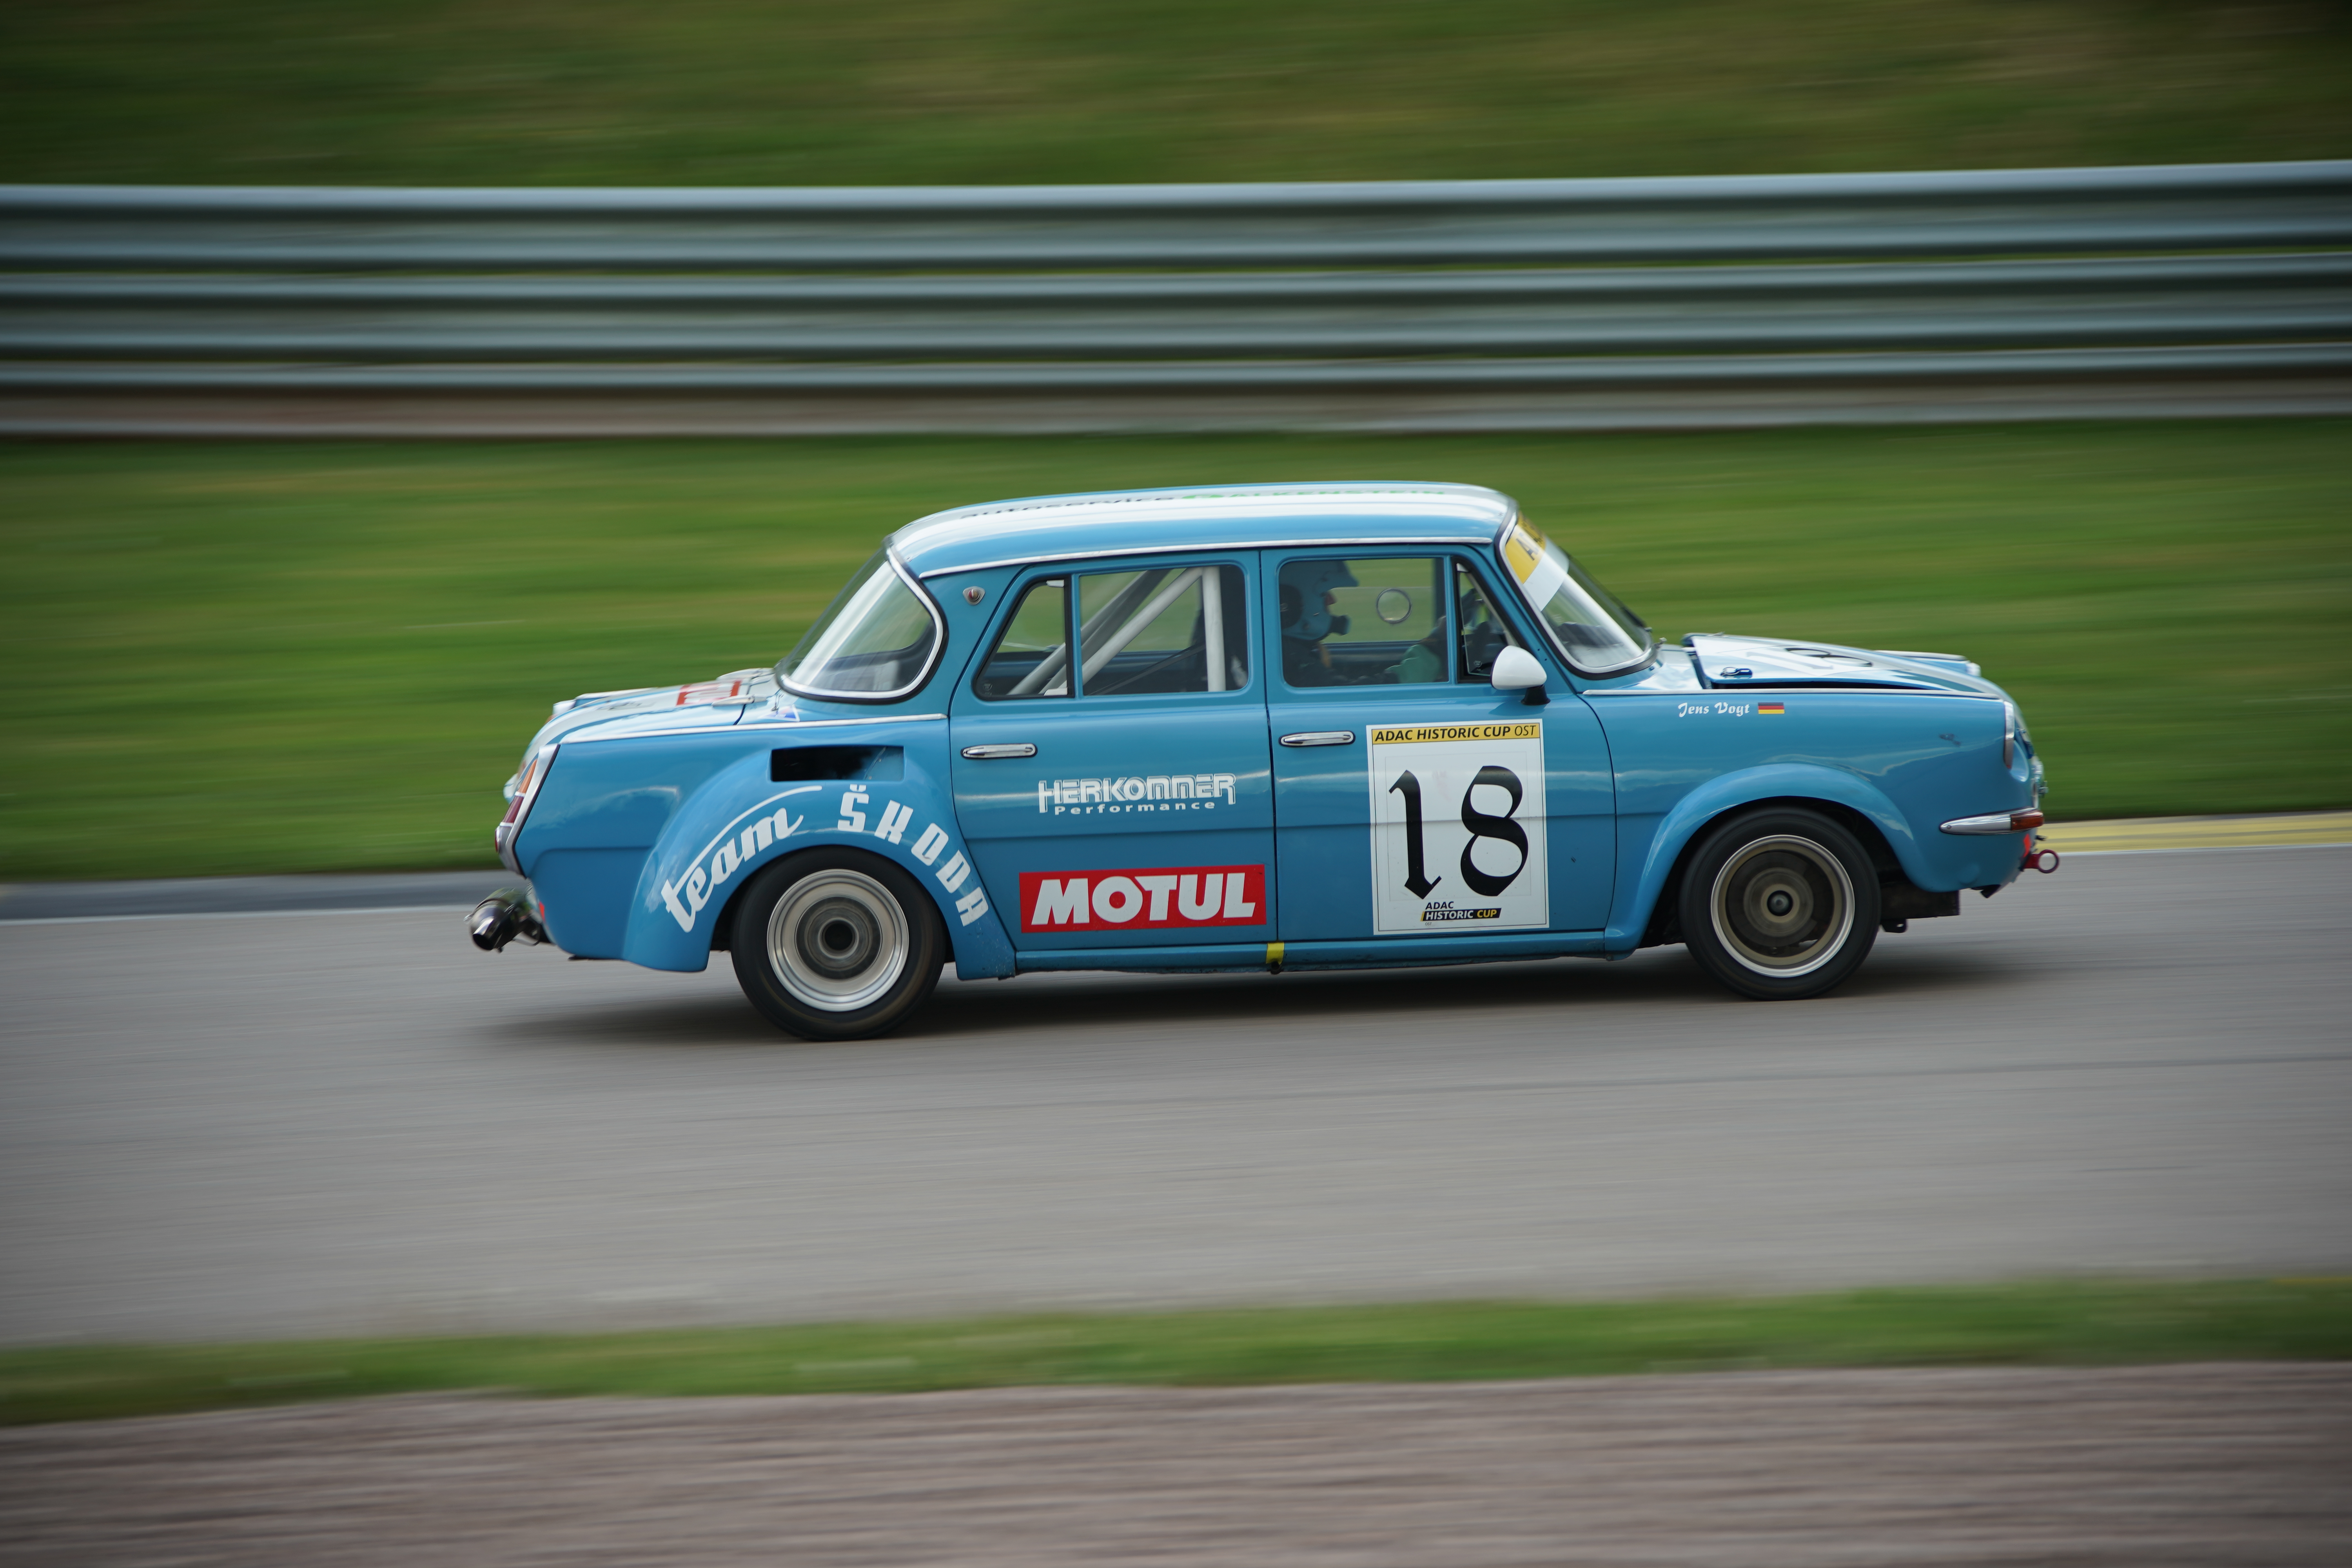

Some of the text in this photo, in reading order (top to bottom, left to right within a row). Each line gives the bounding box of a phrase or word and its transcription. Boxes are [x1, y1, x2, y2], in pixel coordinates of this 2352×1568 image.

[1678, 702, 1750, 718] Jens Vogt
[1374, 725, 1537, 742] ADAC HISTORIC CUP OST
[1038, 773, 1236, 813] HERKOMMER
[1054, 801, 1215, 815] Performance
[1388, 765, 1529, 900] 18
[661, 784, 989, 933] team ŠKODA
[1031, 872, 1256, 926] MOTUL
[1425, 901, 1454, 910] ADAC
[1425, 909, 1497, 920] HISTORIC CUP
